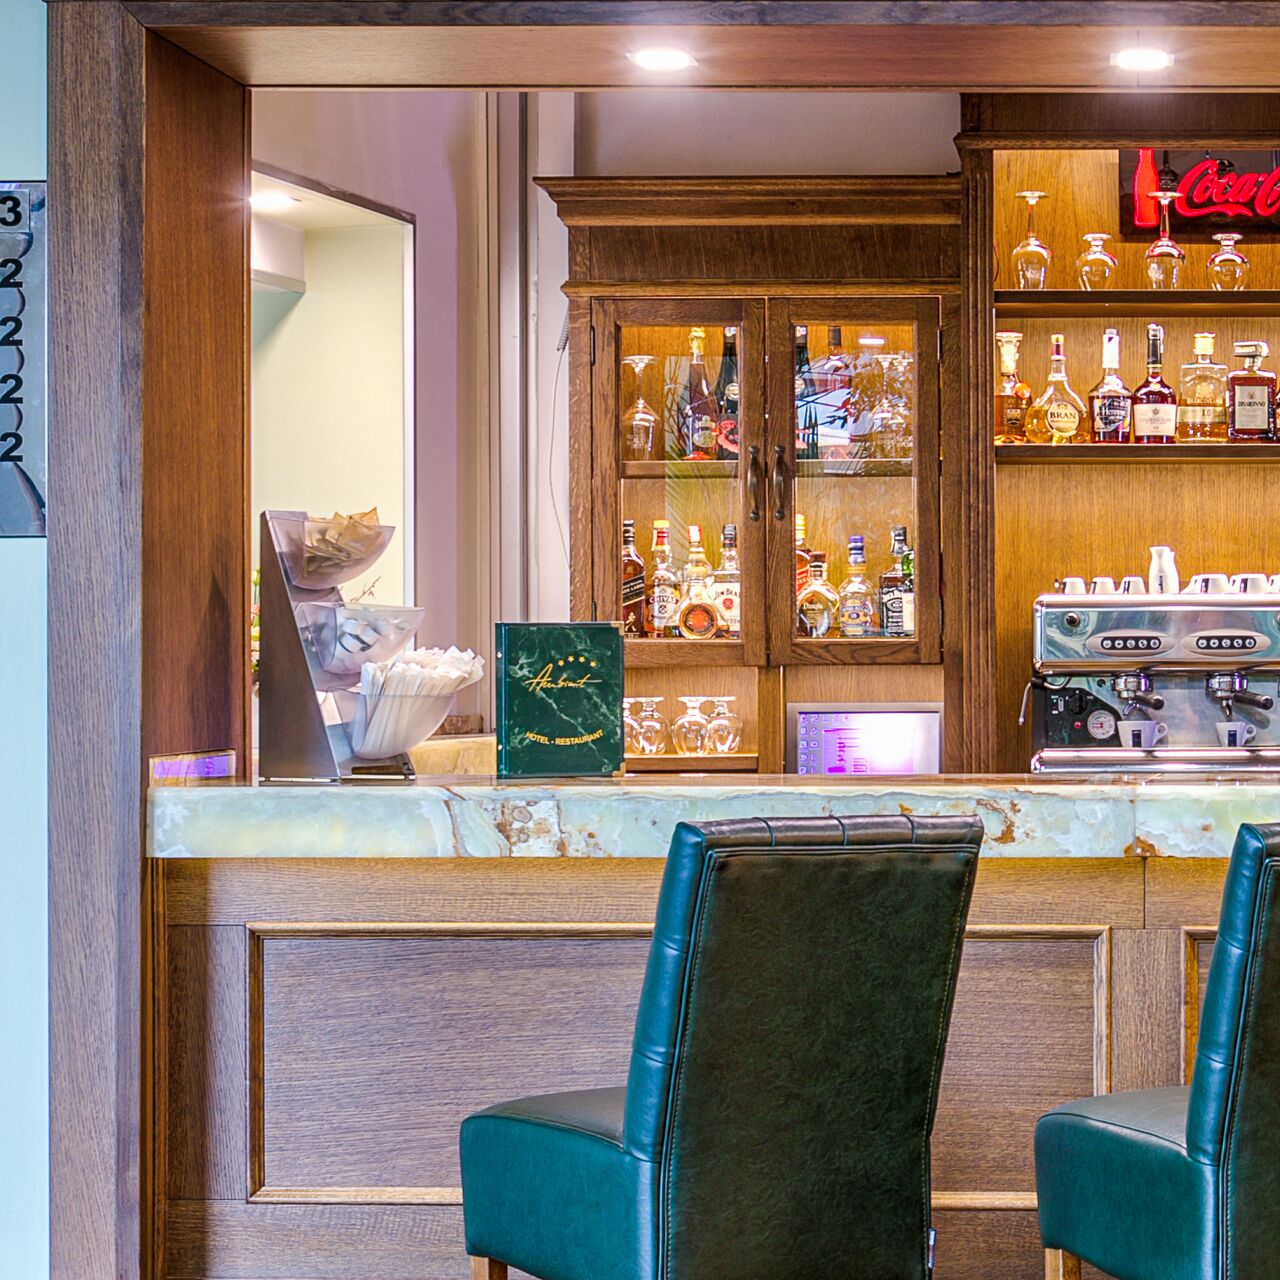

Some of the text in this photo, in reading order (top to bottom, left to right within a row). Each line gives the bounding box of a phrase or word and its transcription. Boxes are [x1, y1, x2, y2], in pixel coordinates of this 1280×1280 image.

[1050, 411, 1076, 420] BRAN
[526, 729, 603, 746] HOTEL RESTAURANT
